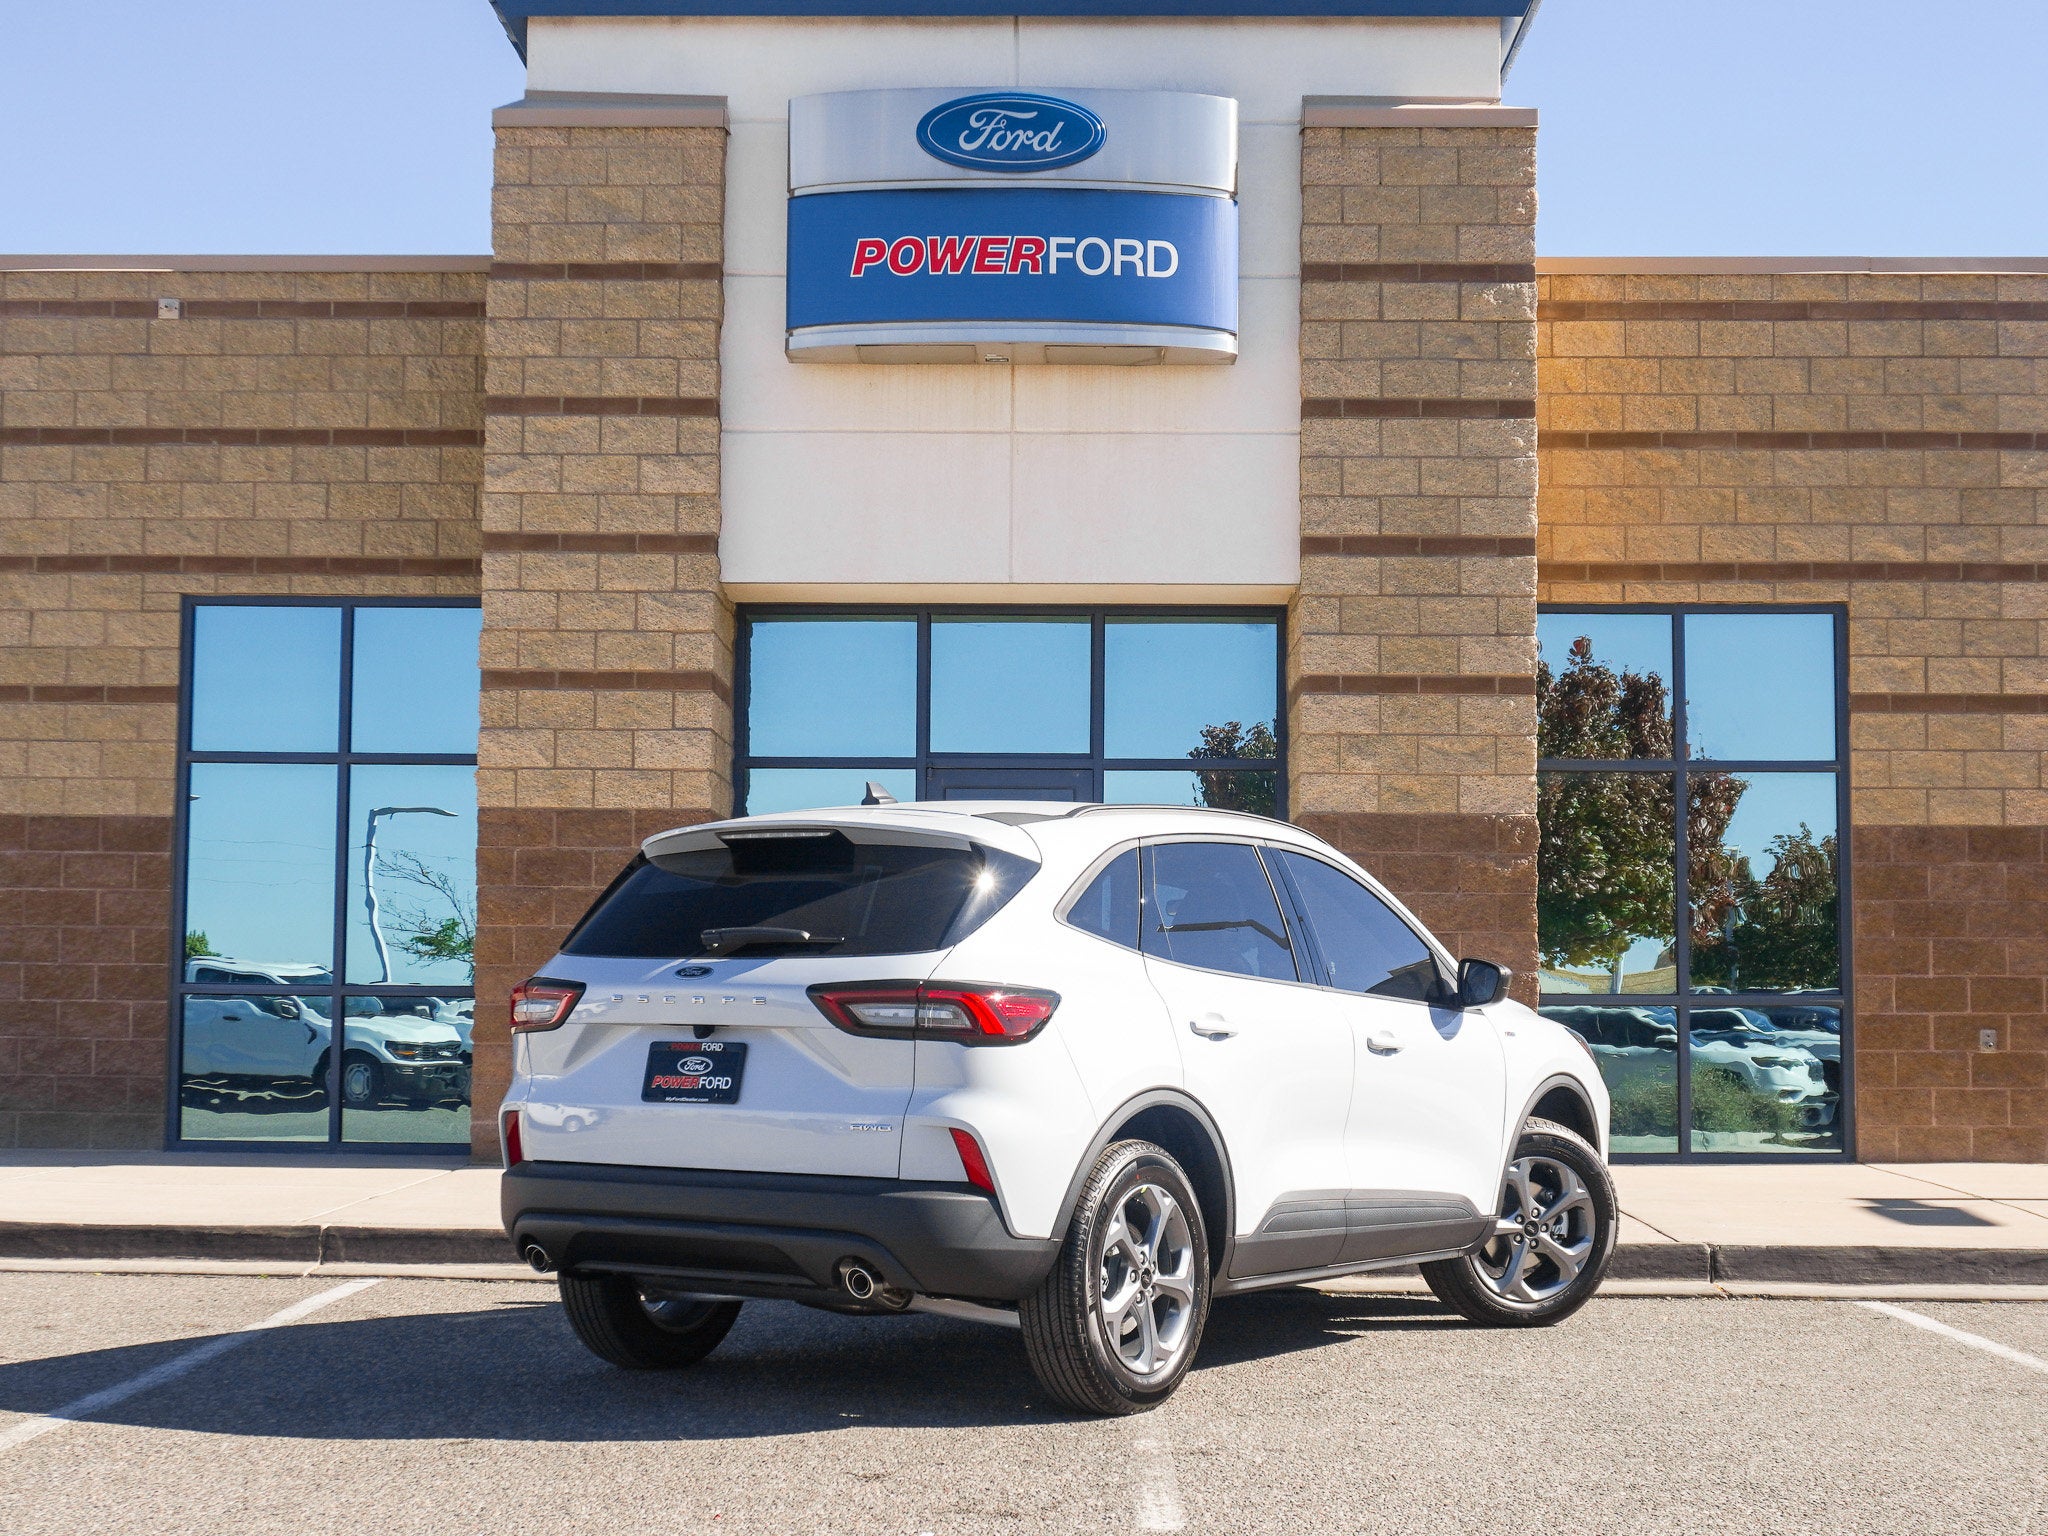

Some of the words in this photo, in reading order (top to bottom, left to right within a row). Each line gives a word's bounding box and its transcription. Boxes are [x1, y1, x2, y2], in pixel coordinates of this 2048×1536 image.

[958, 108, 1064, 152] Ford
[610, 993, 767, 1005] ESCAPE
[849, 1123, 892, 1132] AWD
